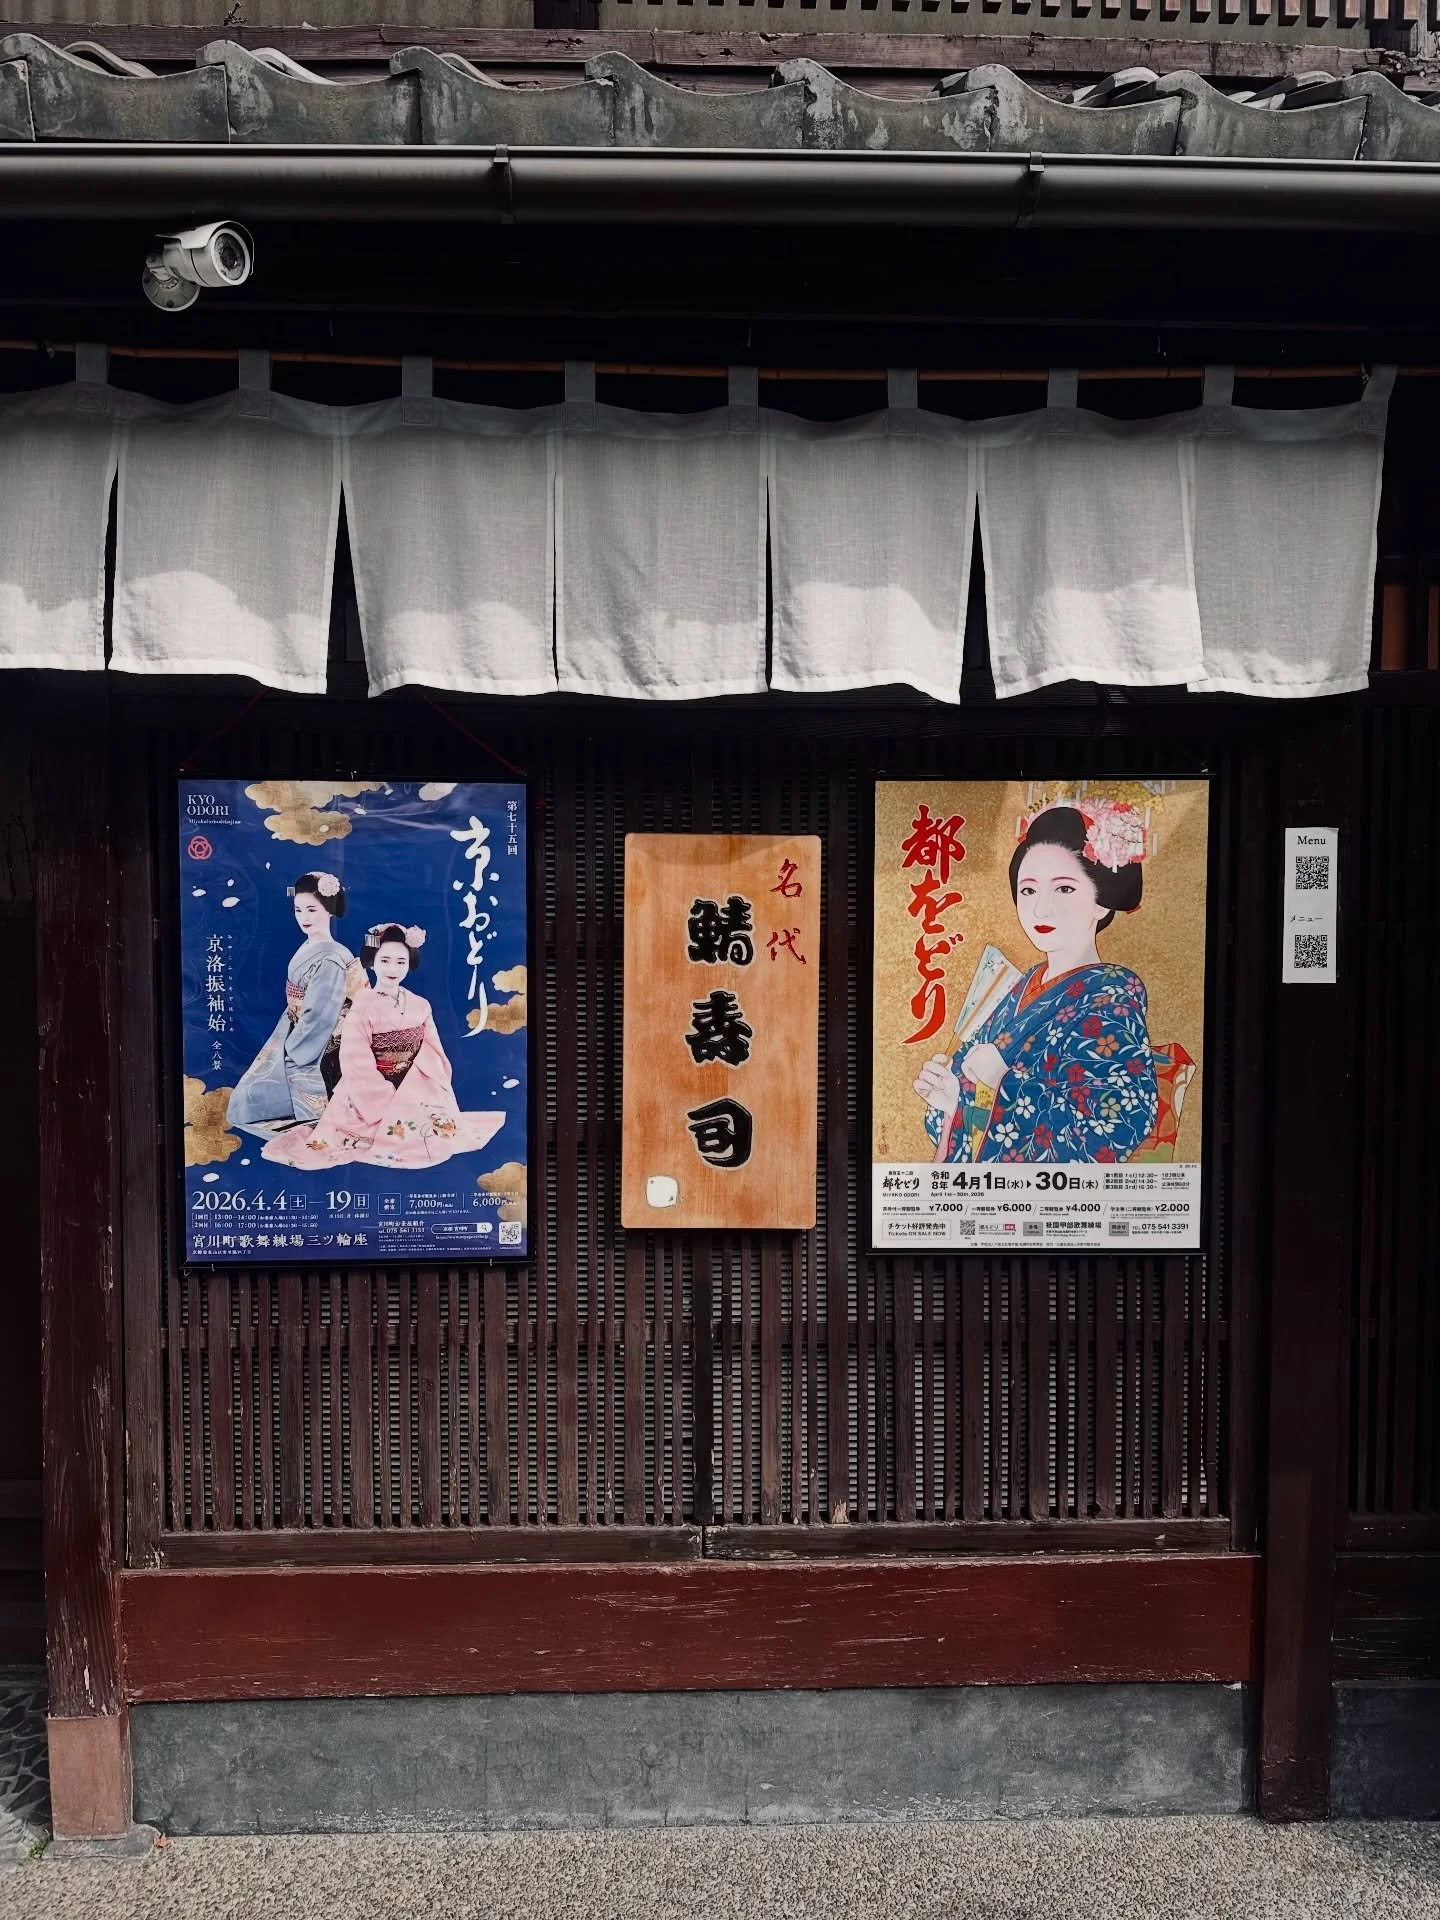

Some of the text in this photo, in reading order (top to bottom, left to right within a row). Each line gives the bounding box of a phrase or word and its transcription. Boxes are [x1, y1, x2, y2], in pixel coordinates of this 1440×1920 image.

[187, 794, 215, 805] KYO
[187, 805, 229, 816] ODORI
[506, 801, 518, 855] 第七十五回
[1297, 835, 1326, 845] Menu
[766, 858, 807, 965] 名代
[1290, 915, 1323, 923] メニュー
[450, 815, 500, 1038] 京おどり
[901, 803, 967, 1045] 都をどり
[205, 934, 226, 1032] 京洛振袖始
[211, 1040, 222, 1070] 全八景
[930, 1170, 950, 1180] 令和
[931, 1181, 949, 1190] 8年
[191, 1188, 287, 1211] 2026.4.4
[325, 1190, 351, 1212] 19
[192, 1232, 368, 1248] 宮川町歌舞練場三ツ輪座
